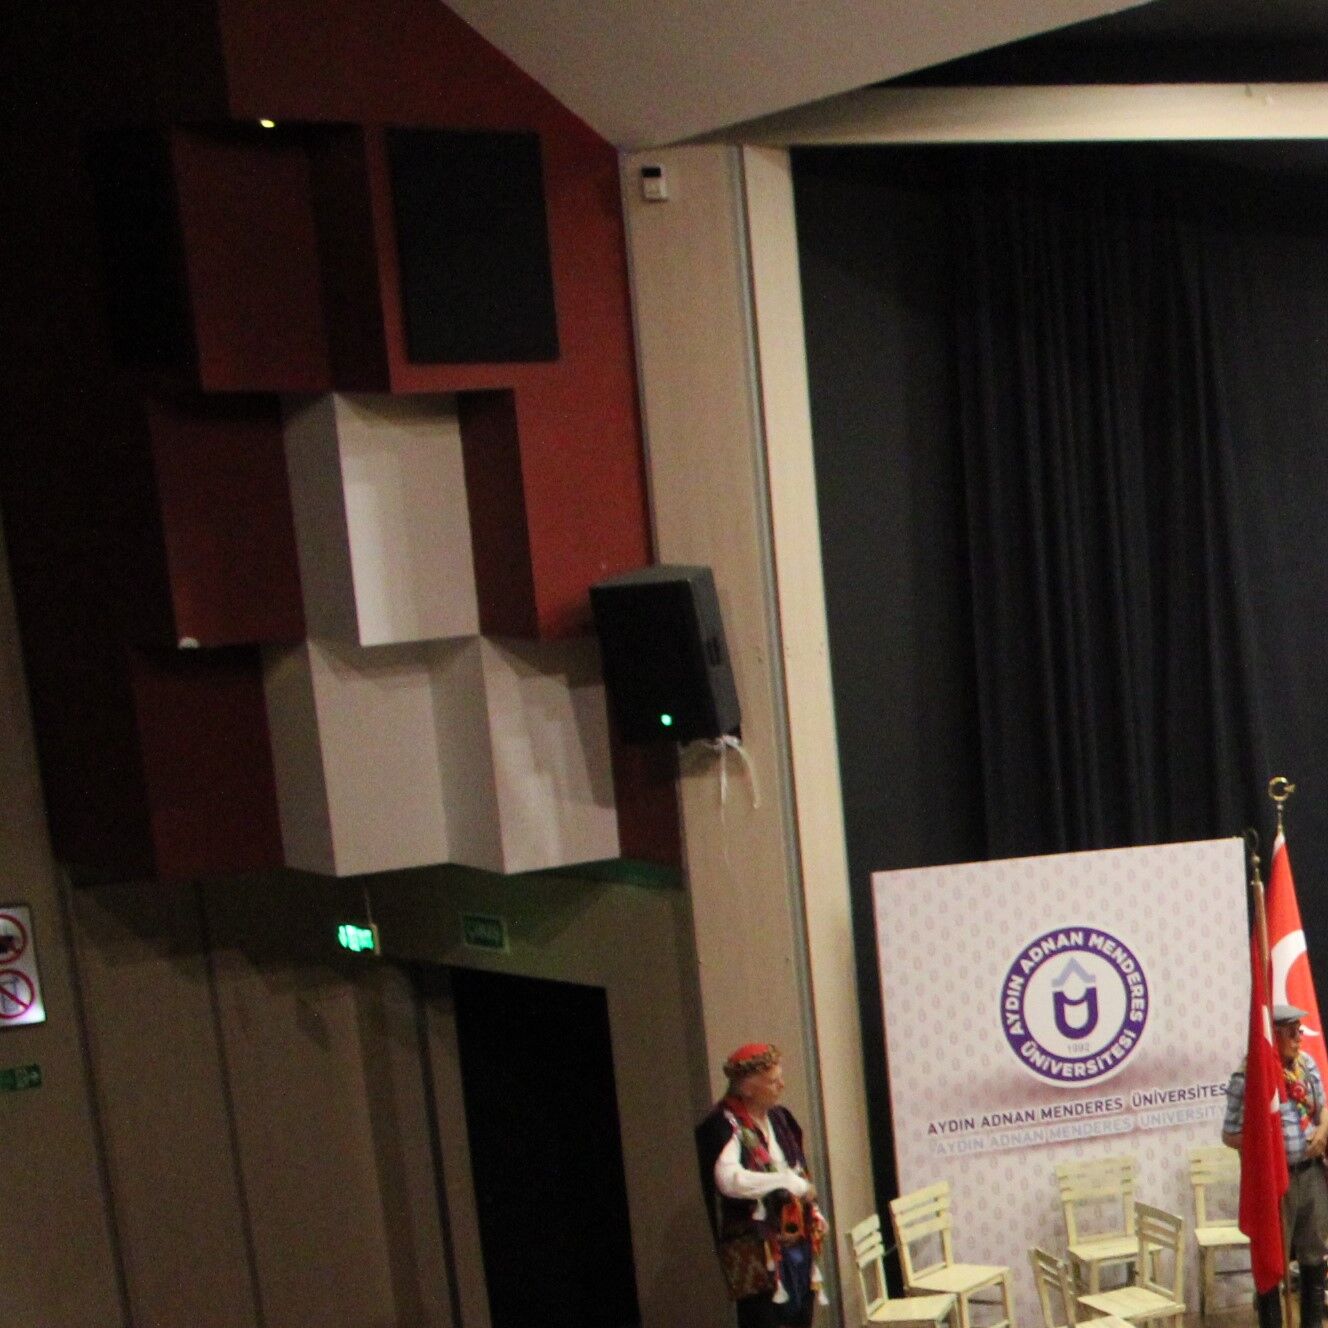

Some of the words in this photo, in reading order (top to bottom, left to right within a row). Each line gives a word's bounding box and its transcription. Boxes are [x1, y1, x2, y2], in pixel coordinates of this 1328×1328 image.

[1005, 974, 1025, 1036] AYDIN
[1020, 931, 1083, 974] ADNAN
[1088, 933, 1144, 1022] MENDERES
[927, 1117, 975, 1136] AYDIN
[981, 1110, 1036, 1128] ADNAN
[1040, 1098, 1123, 1121] MENDERES
[1132, 1083, 1229, 1107] ÜNİVERSİTES
[936, 1138, 984, 1155] AYDIN
[990, 1130, 1045, 1147] ADNAN
[1050, 1118, 1132, 1140] MENDERES
